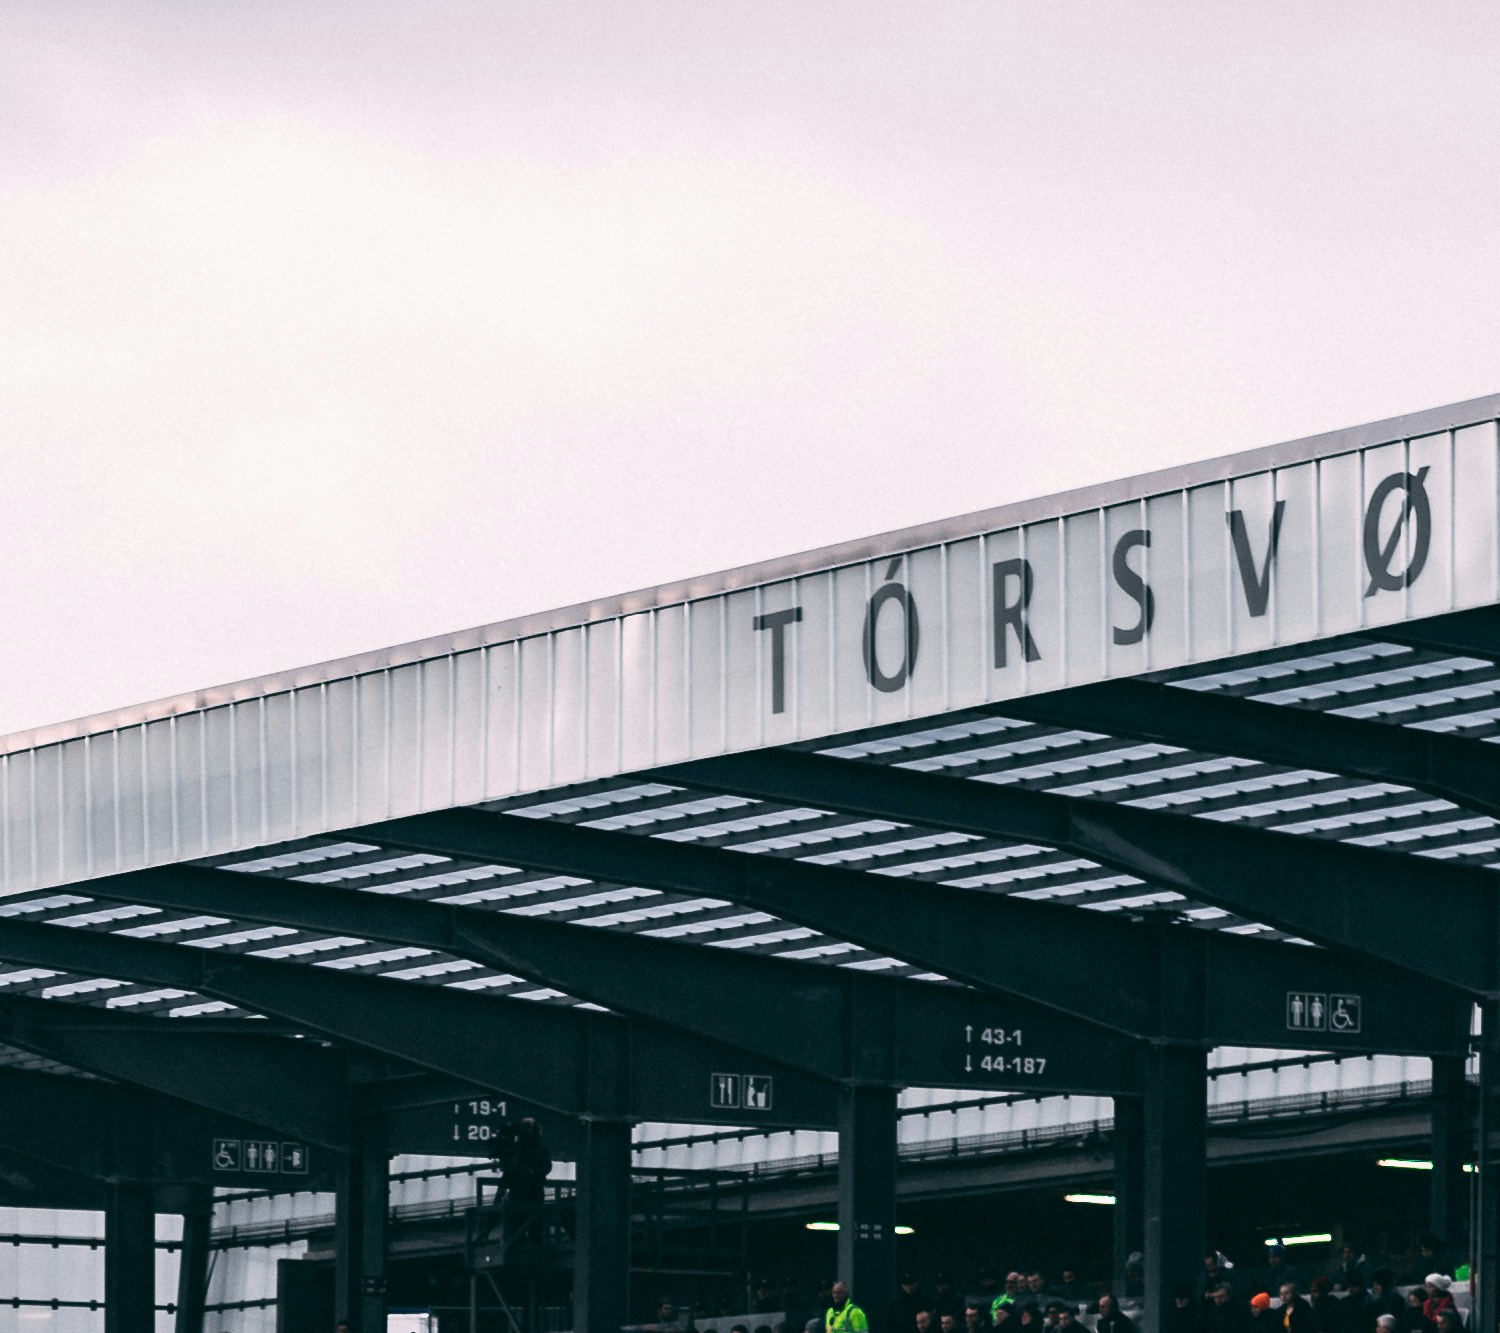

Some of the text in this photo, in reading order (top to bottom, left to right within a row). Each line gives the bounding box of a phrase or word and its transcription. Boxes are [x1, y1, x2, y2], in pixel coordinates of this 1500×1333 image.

[980, 1027, 1022, 1046] 43-1
[980, 1055, 1047, 1074] 44-187
[468, 1100, 507, 1117] 19-1
